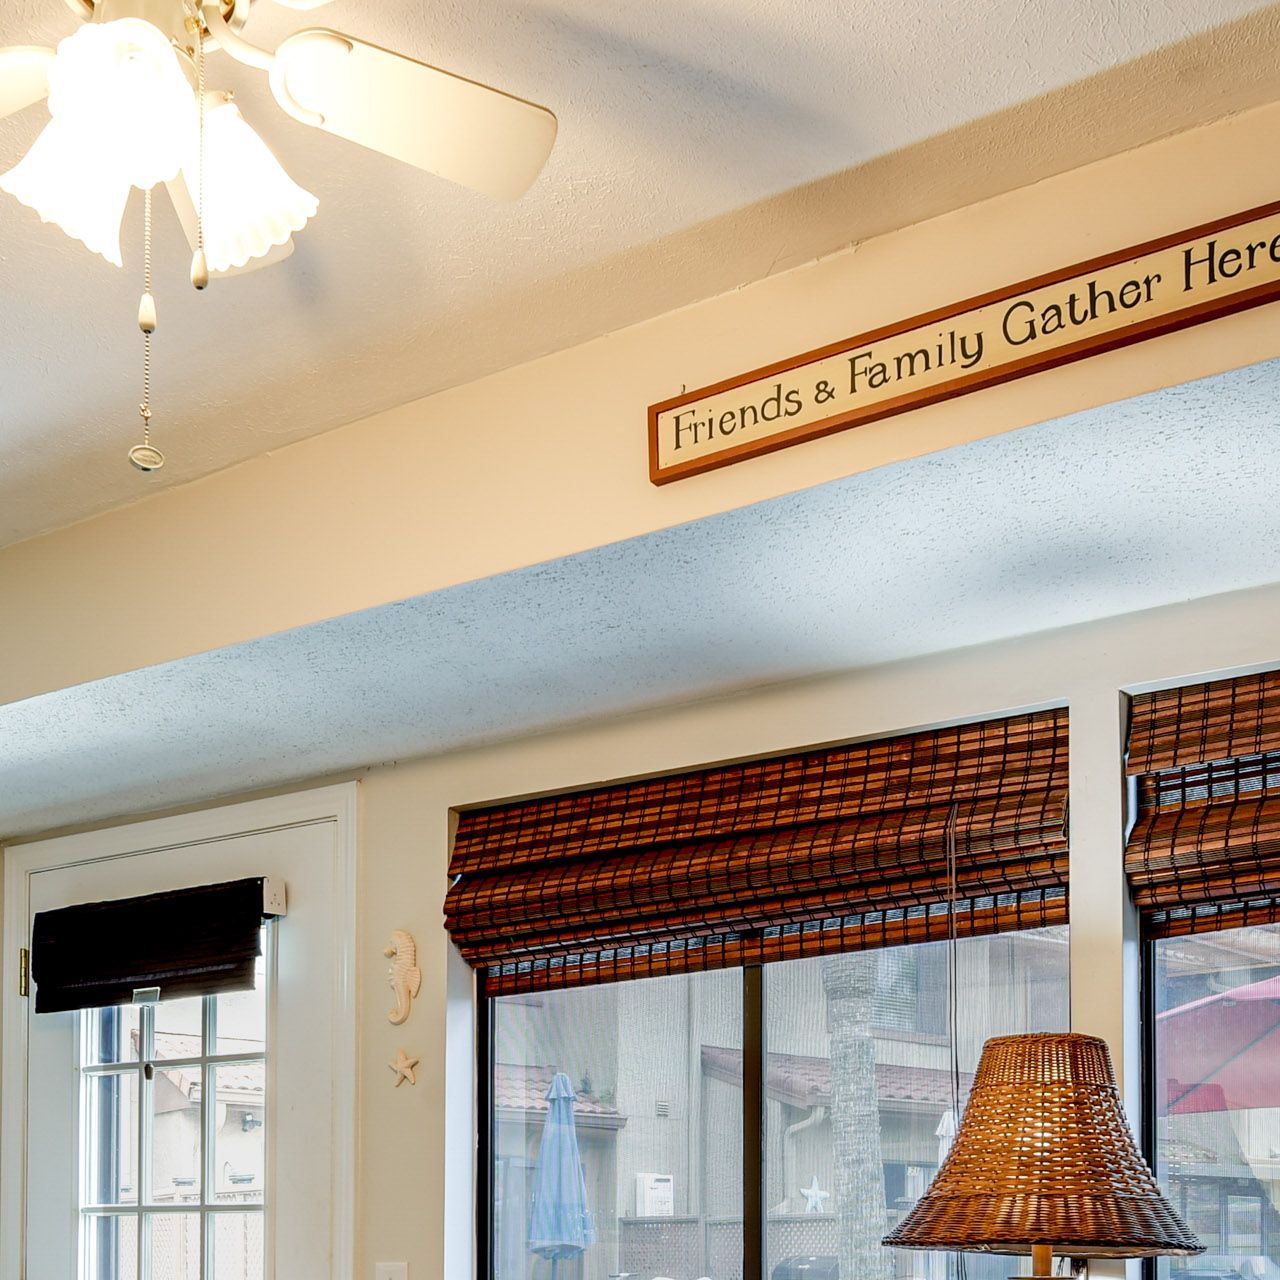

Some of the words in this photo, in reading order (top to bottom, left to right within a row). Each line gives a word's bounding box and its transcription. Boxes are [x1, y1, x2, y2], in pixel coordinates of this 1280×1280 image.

[673, 383, 803, 451] Friends
[814, 380, 836, 405] &
[848, 332, 984, 397] Family
[1001, 273, 1162, 345] Gather
